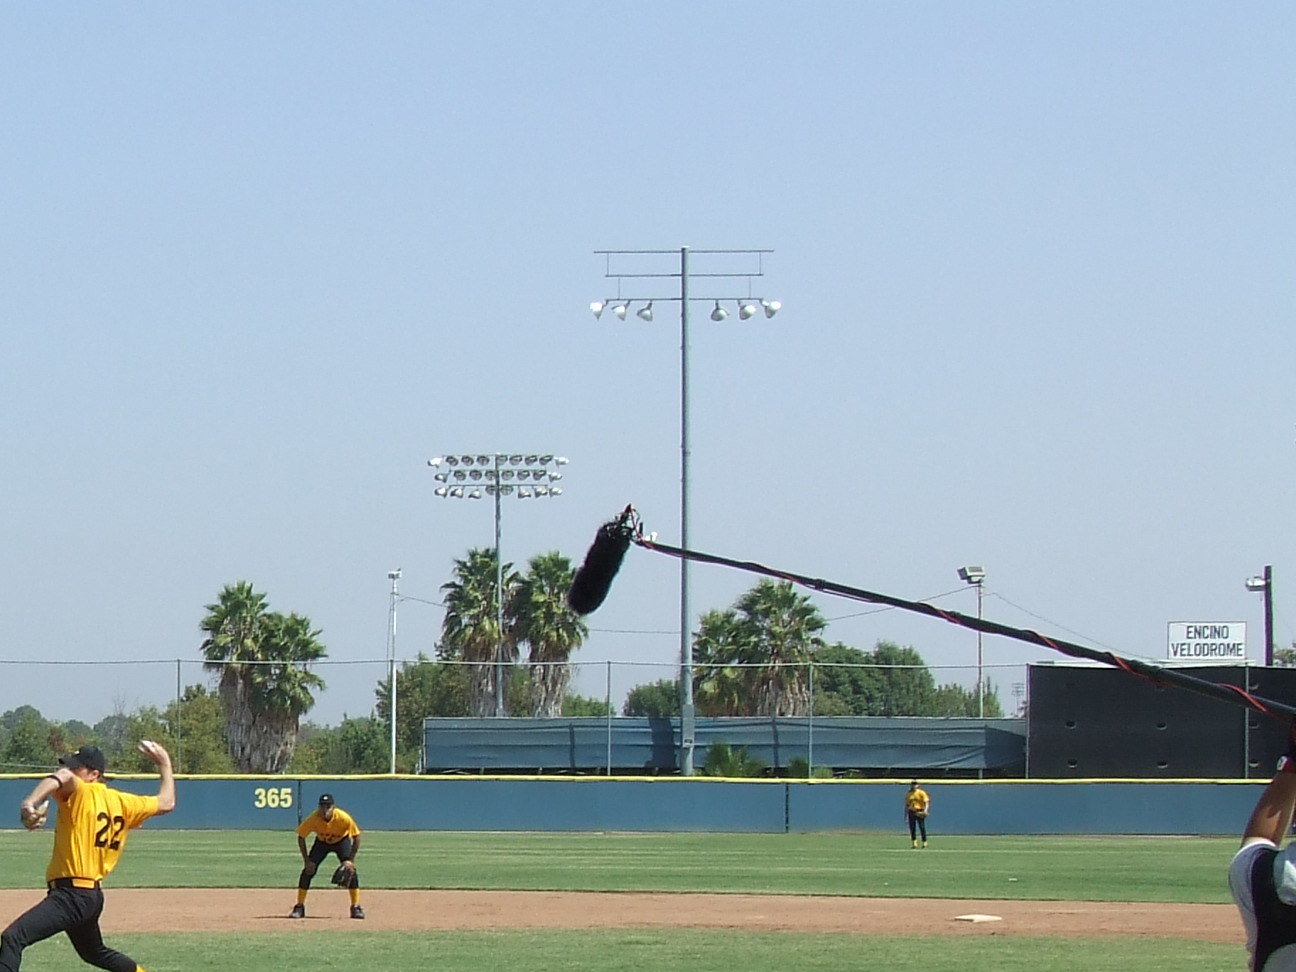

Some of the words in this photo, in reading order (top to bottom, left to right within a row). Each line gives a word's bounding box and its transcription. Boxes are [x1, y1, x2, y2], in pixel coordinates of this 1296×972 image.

[1186, 625, 1229, 640] ENCINO
[1171, 643, 1243, 657] VELODROME
[254, 787, 293, 808] 365
[94, 812, 125, 851] 22
